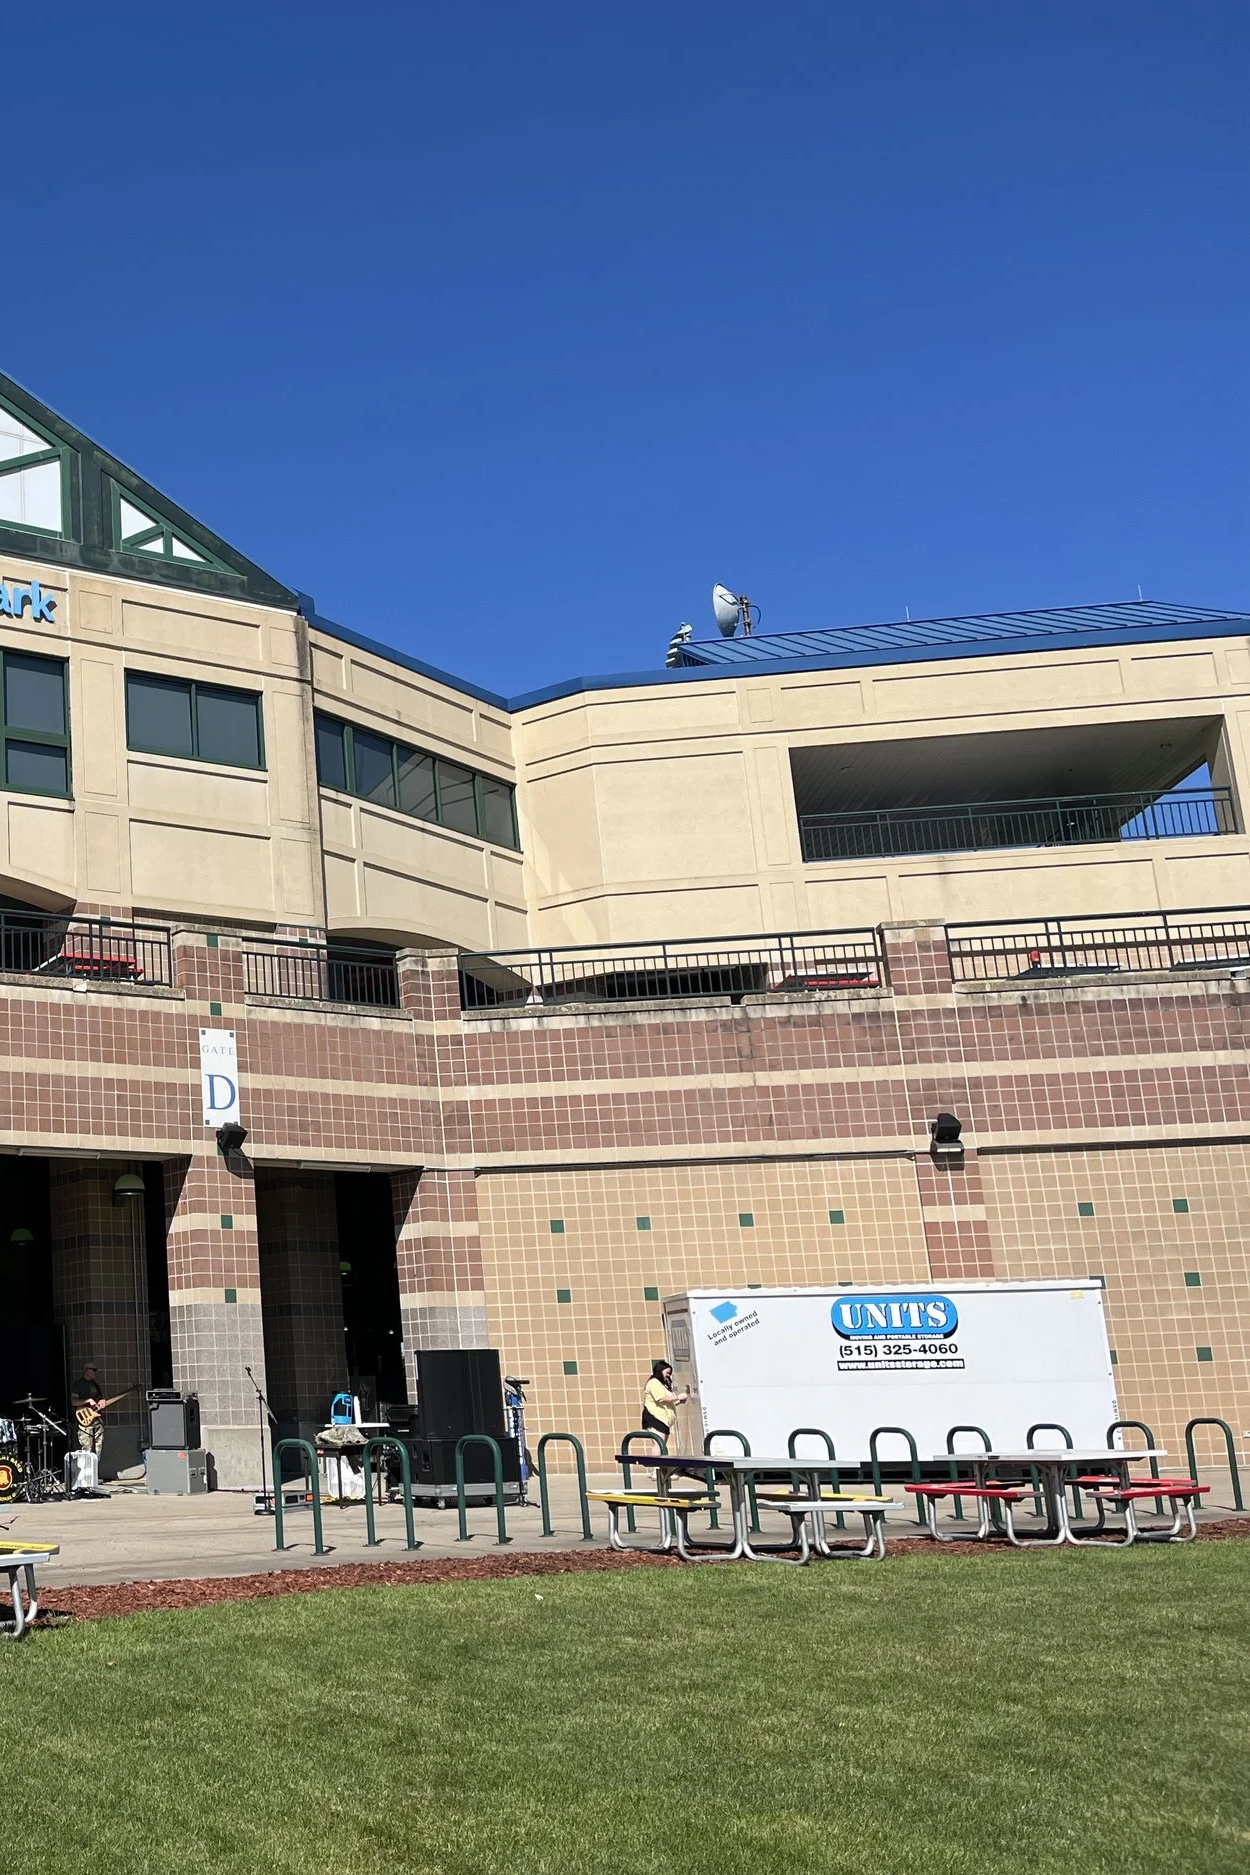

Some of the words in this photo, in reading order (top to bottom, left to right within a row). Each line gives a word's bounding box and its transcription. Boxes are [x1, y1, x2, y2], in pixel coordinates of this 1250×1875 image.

[202, 1045, 235, 1056] GATE
[205, 1074, 236, 1110] D
[707, 1323, 733, 1340] Locally
[734, 1310, 758, 1327] owned
[839, 1301, 949, 1329] UNITS
[714, 1334, 728, 1346] and
[728, 1318, 760, 1339] operated
[839, 1345, 878, 1358] (515)
[882, 1343, 958, 1355] 325-4060
[838, 1360, 963, 1370] www.unitsstorage.com
